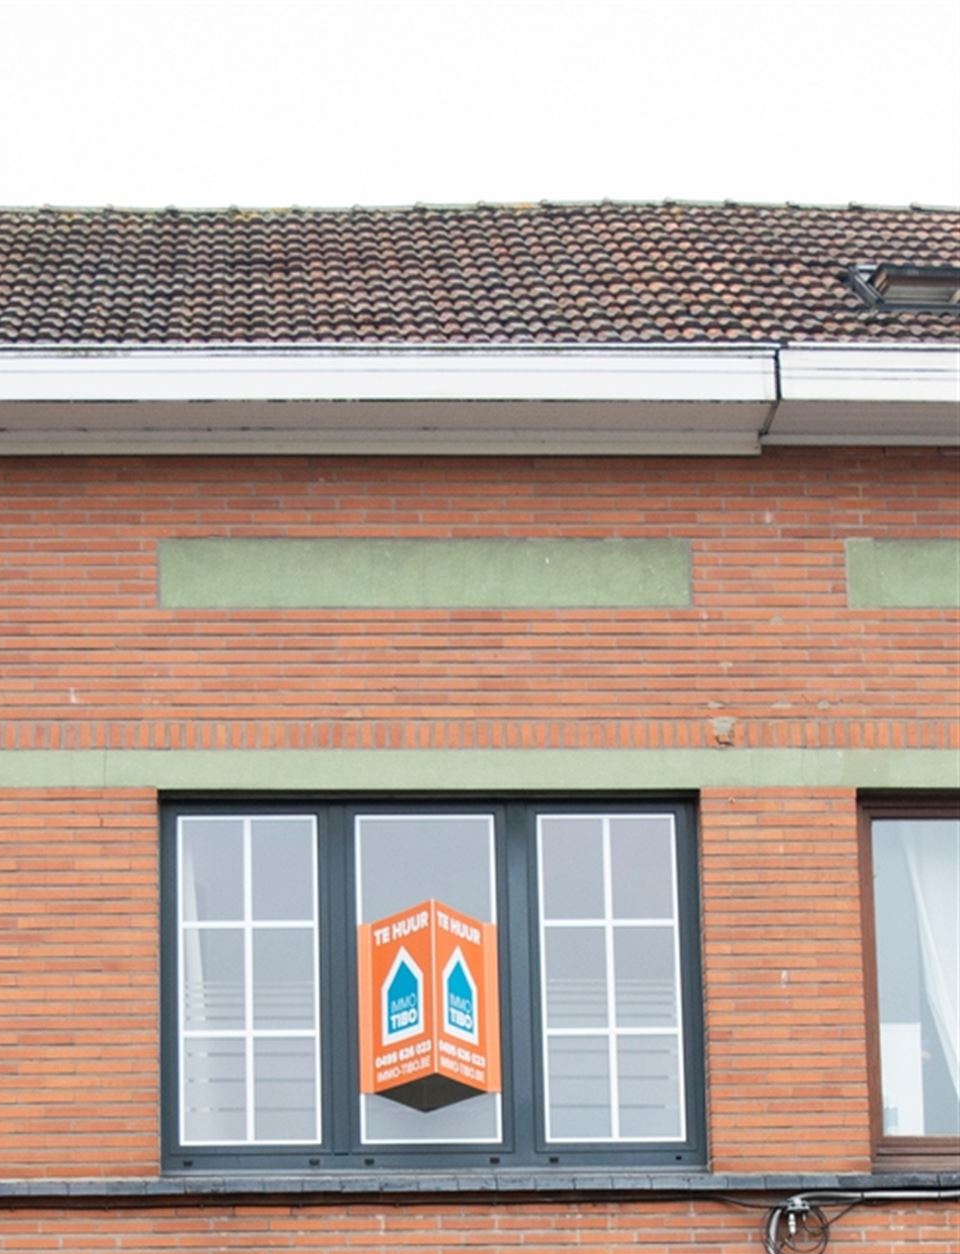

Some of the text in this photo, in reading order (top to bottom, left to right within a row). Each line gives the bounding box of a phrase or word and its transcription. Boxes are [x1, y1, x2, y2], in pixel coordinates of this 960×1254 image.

[374, 910, 429, 946] TE HUUR
[436, 910, 482, 945] TE HUUR
[391, 1008, 417, 1030] TIBO
[449, 1008, 473, 1030] TIBO
